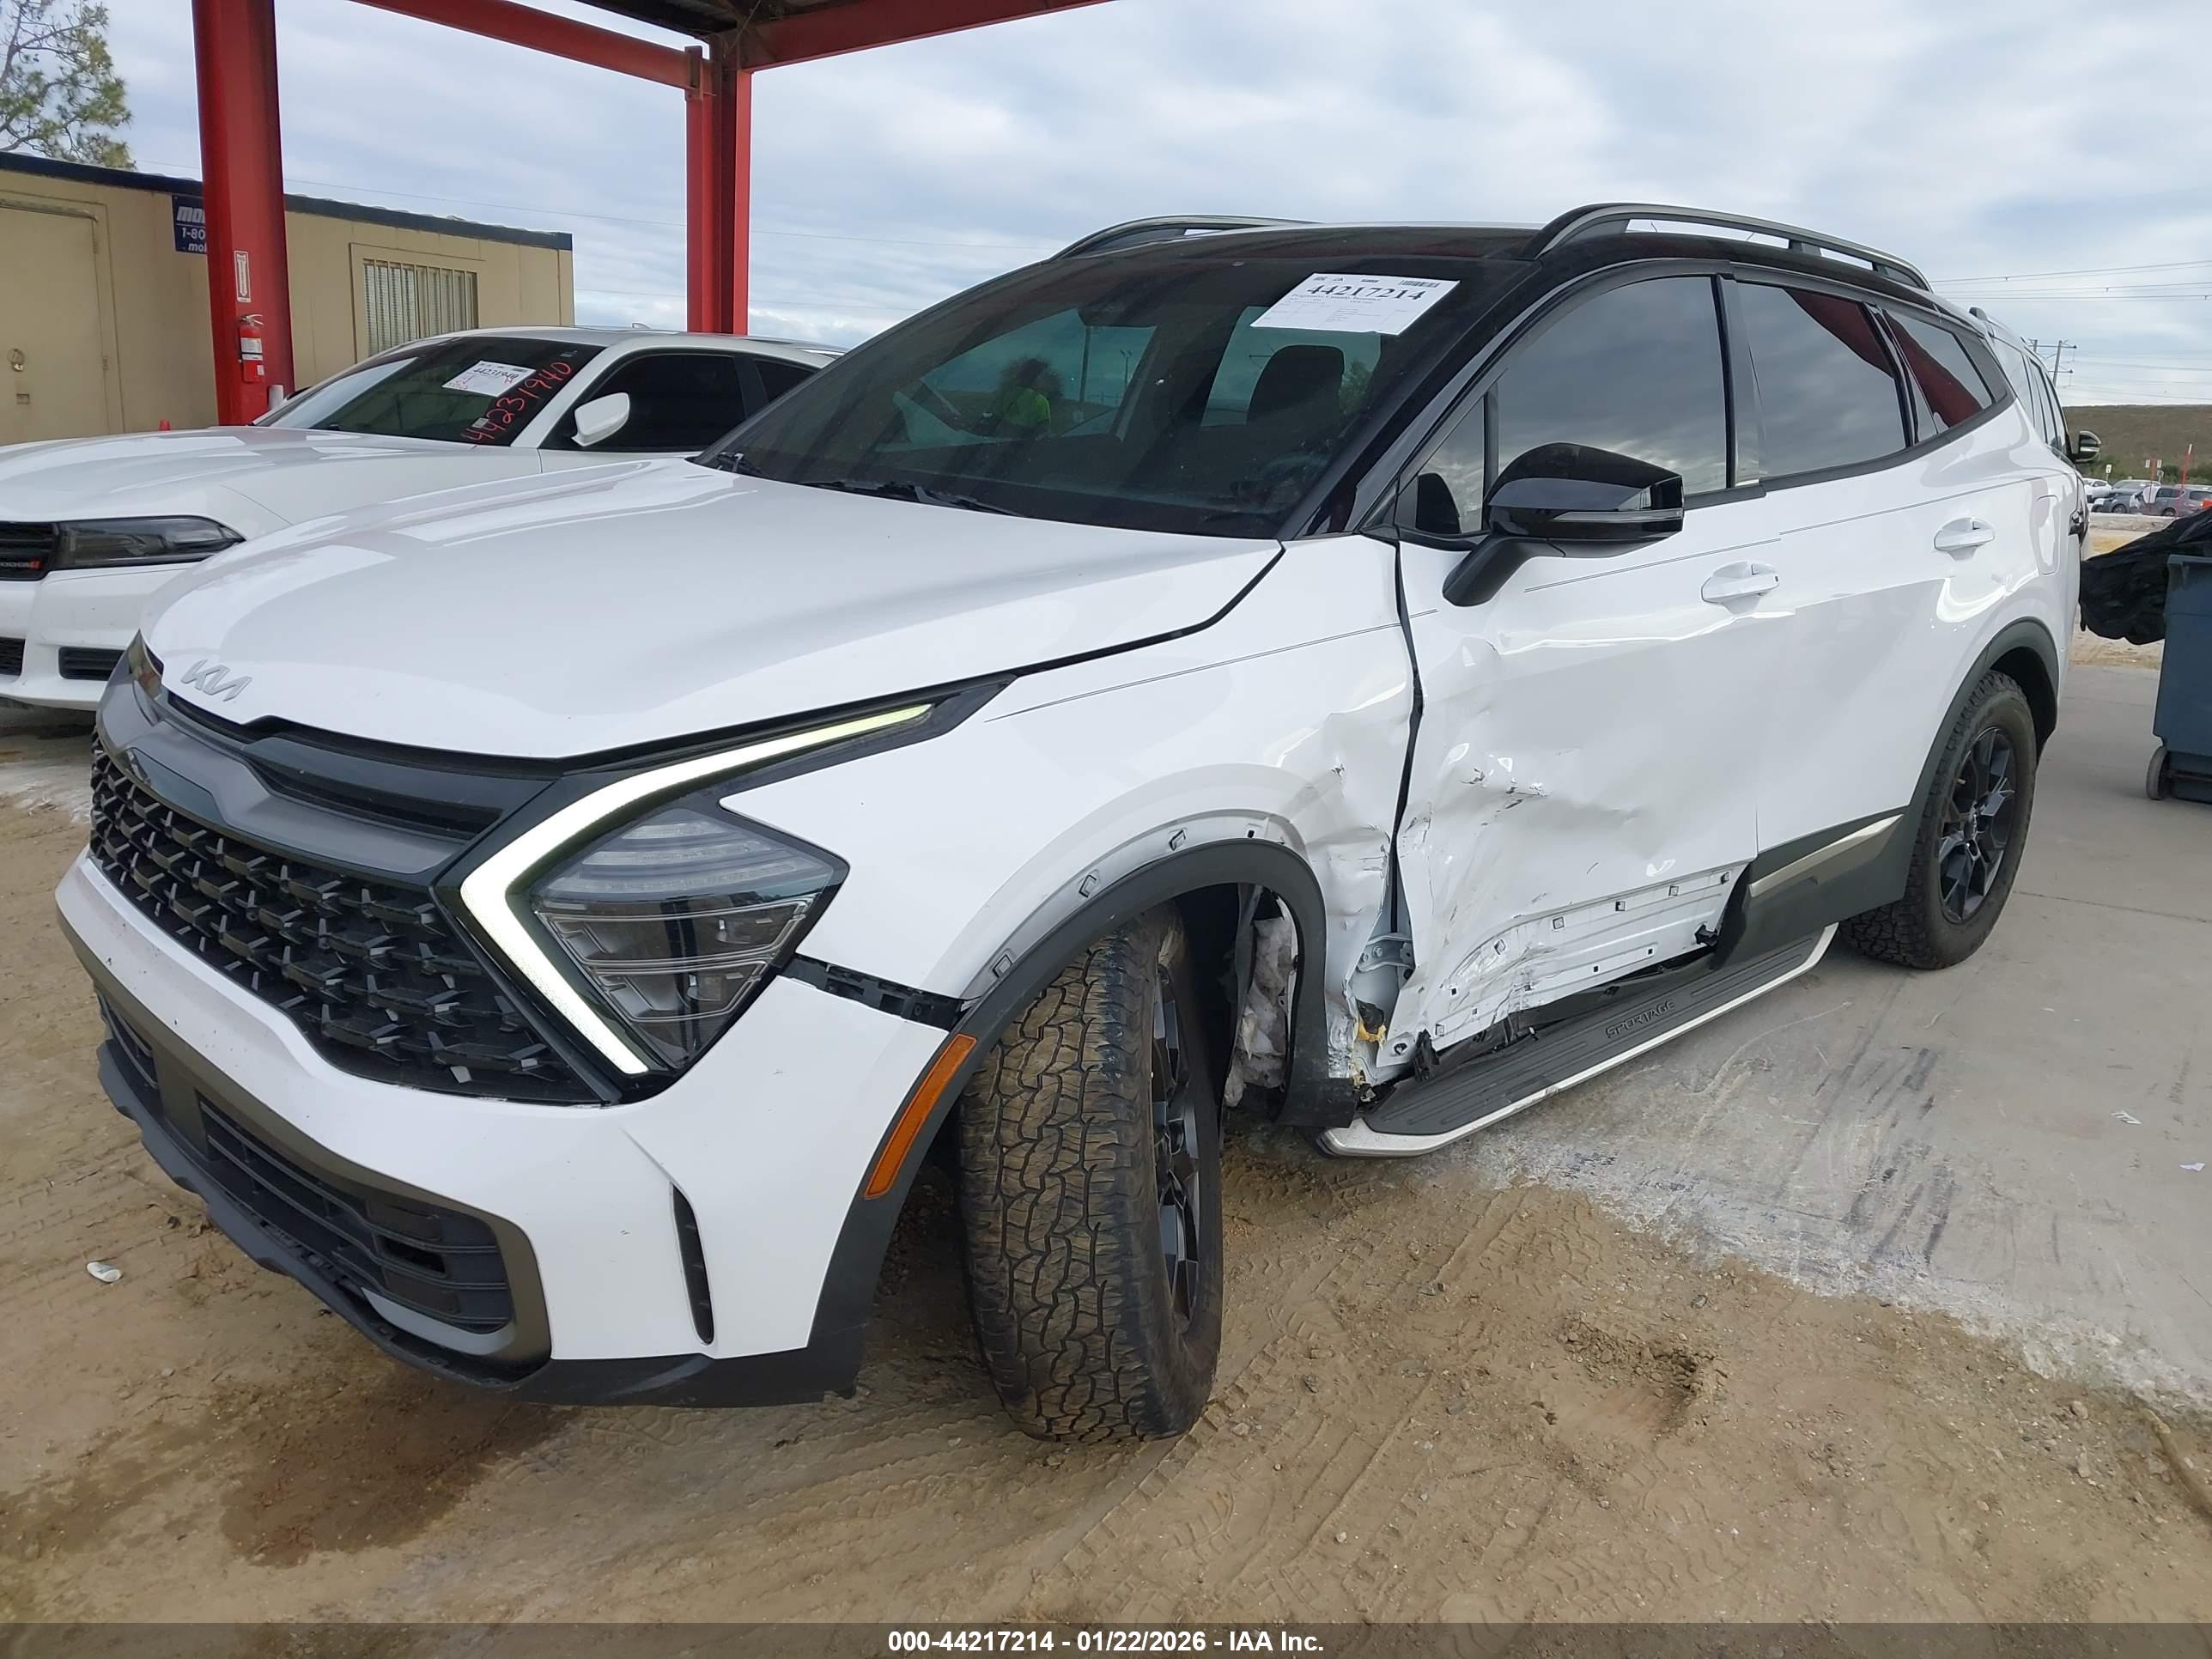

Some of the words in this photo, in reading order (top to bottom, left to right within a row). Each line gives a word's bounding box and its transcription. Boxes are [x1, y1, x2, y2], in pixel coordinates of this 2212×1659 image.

[188, 242, 207, 252] mo
[1306, 284, 1427, 301] 44217214
[460, 362, 572, 441] 44231940
[180, 659, 252, 702] KIA
[1606, 999, 1676, 1039] SPORTAGE
